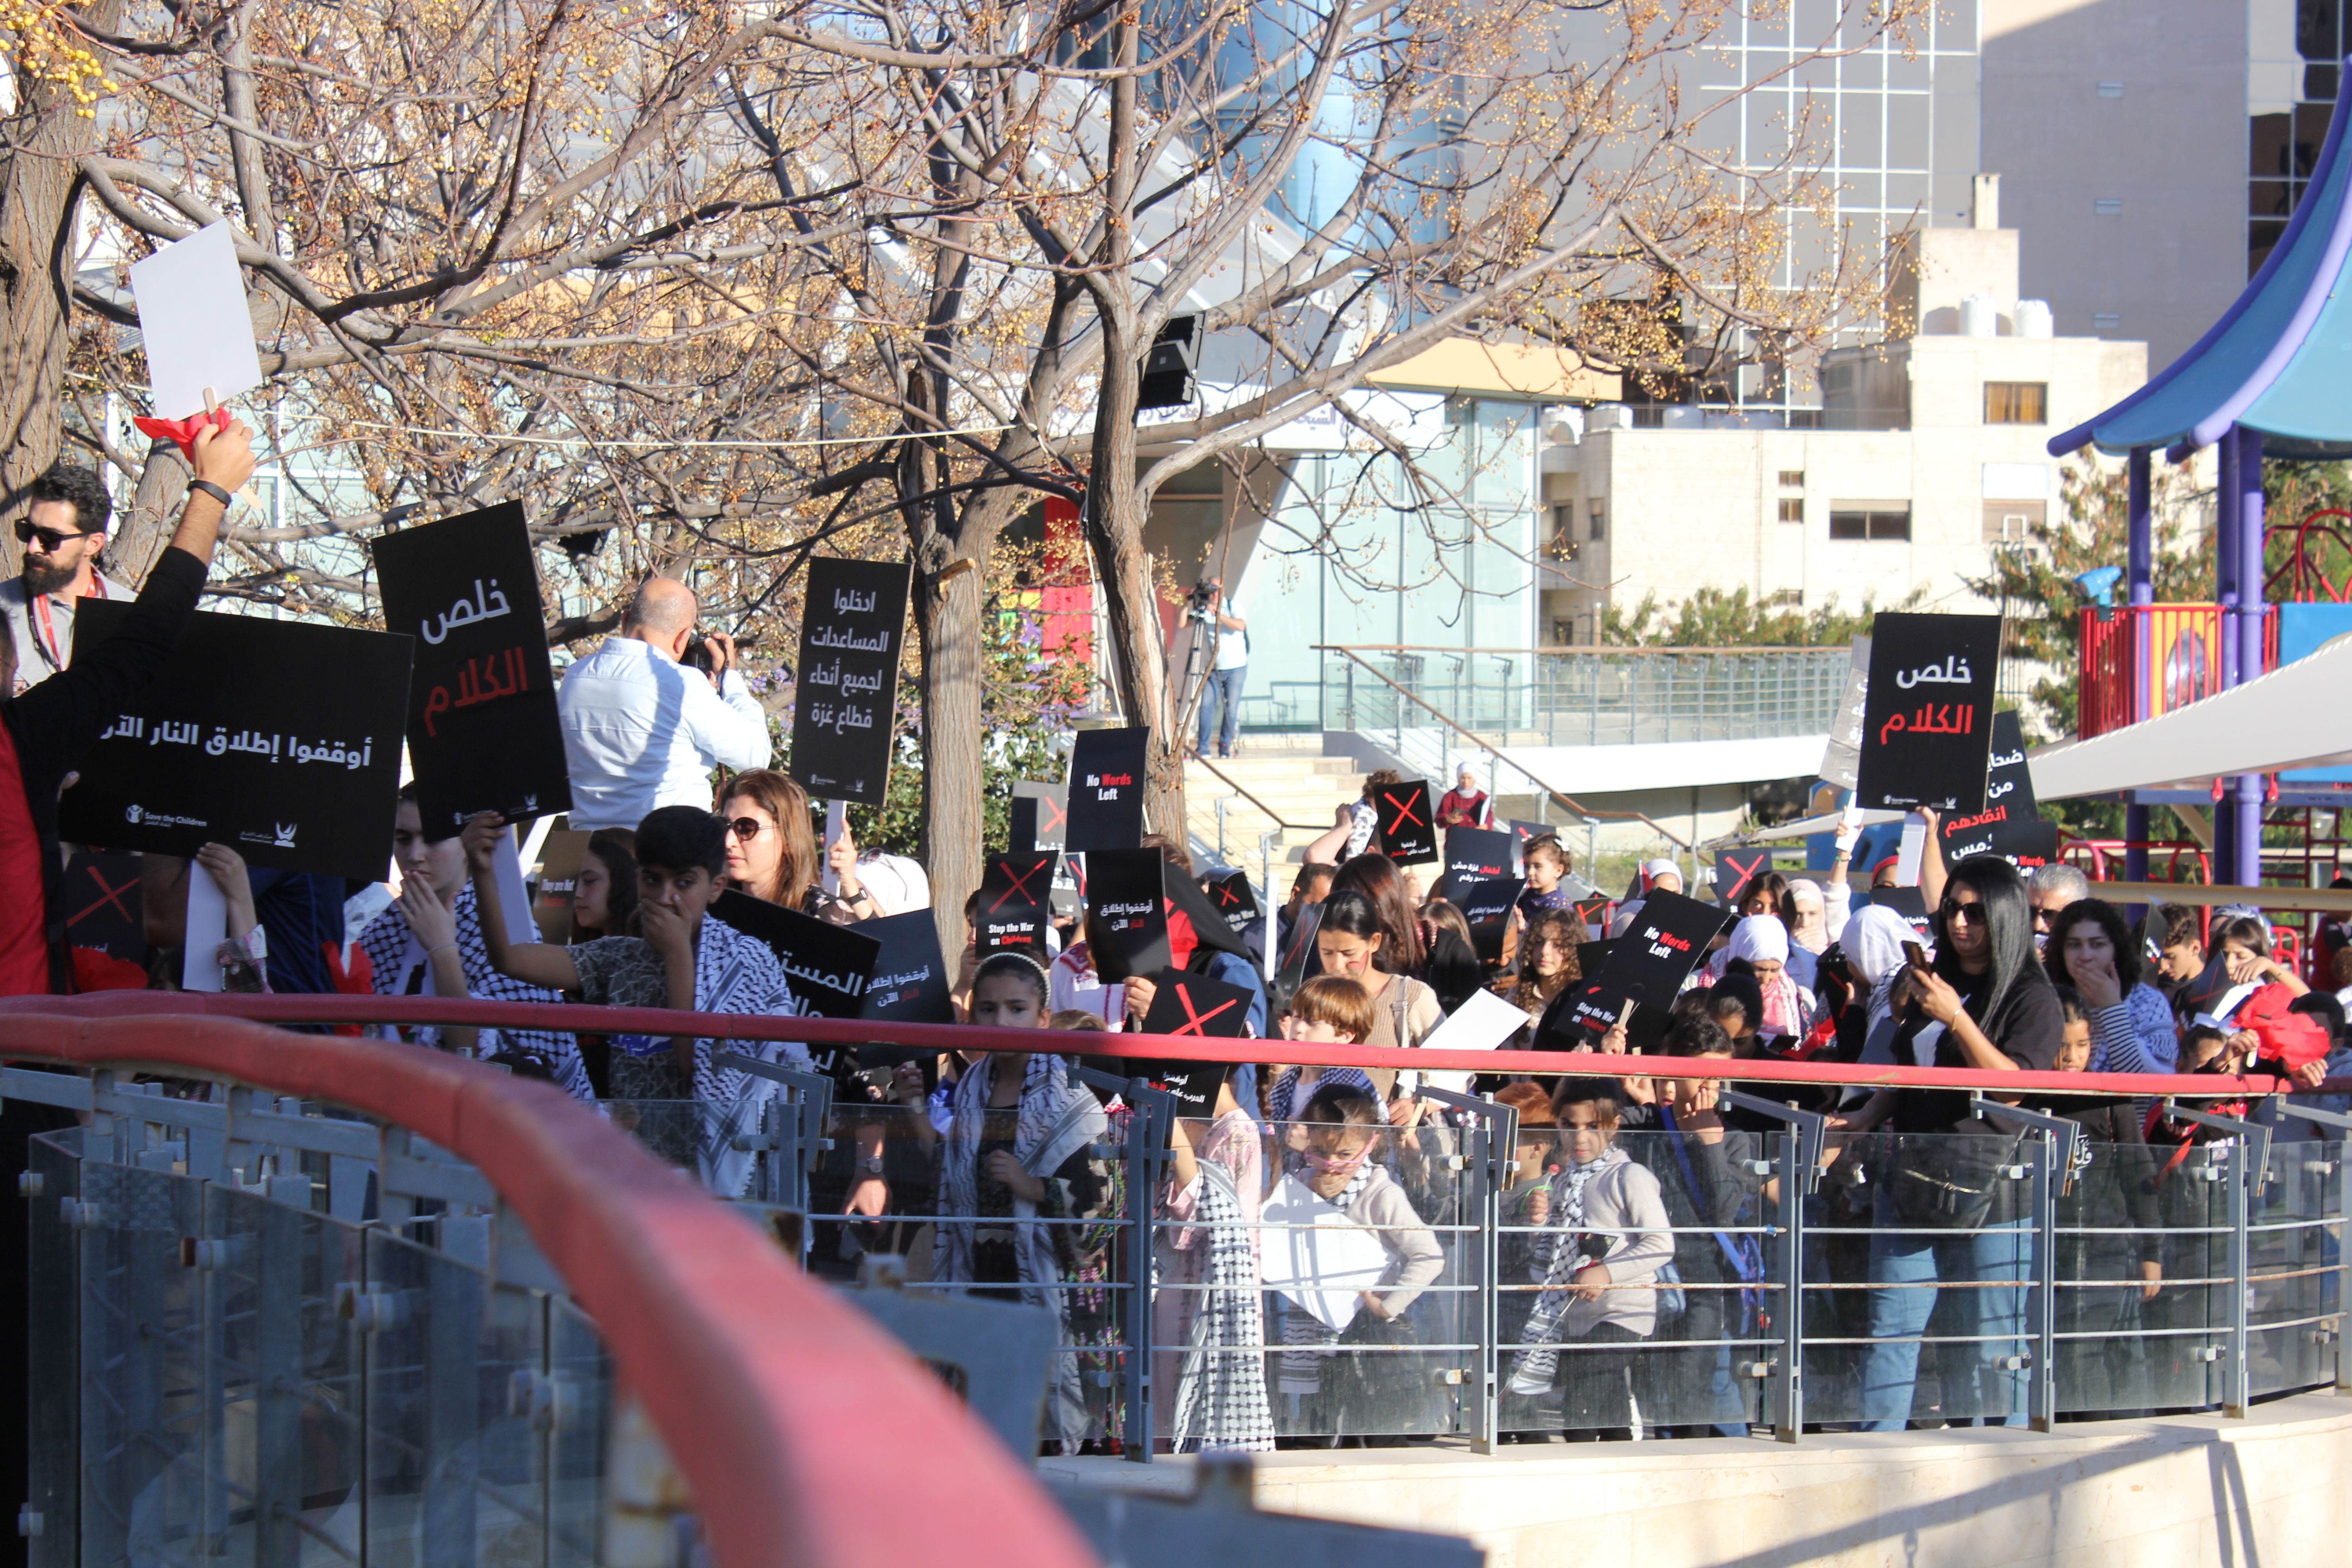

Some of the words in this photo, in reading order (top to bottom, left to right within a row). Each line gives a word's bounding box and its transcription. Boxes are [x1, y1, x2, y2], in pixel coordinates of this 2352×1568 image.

[421, 578, 511, 644] خلص
[834, 588, 876, 615] ادخلوا
[810, 625, 889, 652] المساعدات
[809, 658, 840, 686] أنحاء
[841, 670, 882, 697] لجميع
[1896, 655, 1972, 689] خلص
[424, 647, 529, 737] الكلام
[810, 703, 833, 728] غزة
[835, 705, 872, 735] قطاع
[1880, 703, 1974, 745] الكلام
[150, 720, 199, 745] النار
[205, 727, 280, 763] إطلاق
[288, 737, 372, 769] أوقفوا
[1987, 749, 2024, 773] ضحا
[1086, 774, 1100, 787] No
[1102, 773, 1132, 786] Words
[1988, 781, 2014, 799] من
[1098, 788, 1118, 801] Left
[145, 812, 162, 821] Save
[163, 814, 175, 823] the
[176, 816, 207, 827] Children
[1467, 863, 1480, 872] غزة
[2019, 855, 2047, 867] Words
[1100, 903, 1125, 917] إطلاق
[1126, 899, 1153, 915] أوقفوا
[988, 924, 1006, 935] Stop
[1006, 923, 1019, 933] the
[1019, 922, 1035, 932] War
[1643, 926, 1660, 940] No
[1659, 931, 1691, 951] Words
[990, 938, 1000, 946] on
[1648, 941, 1672, 959] Left
[893, 965, 930, 986] أوقفوا
[1572, 1014, 1582, 1024] on
[1576, 1002, 1593, 1015] Stop
[1590, 1007, 1603, 1018] the
[1602, 1011, 1616, 1023] War
